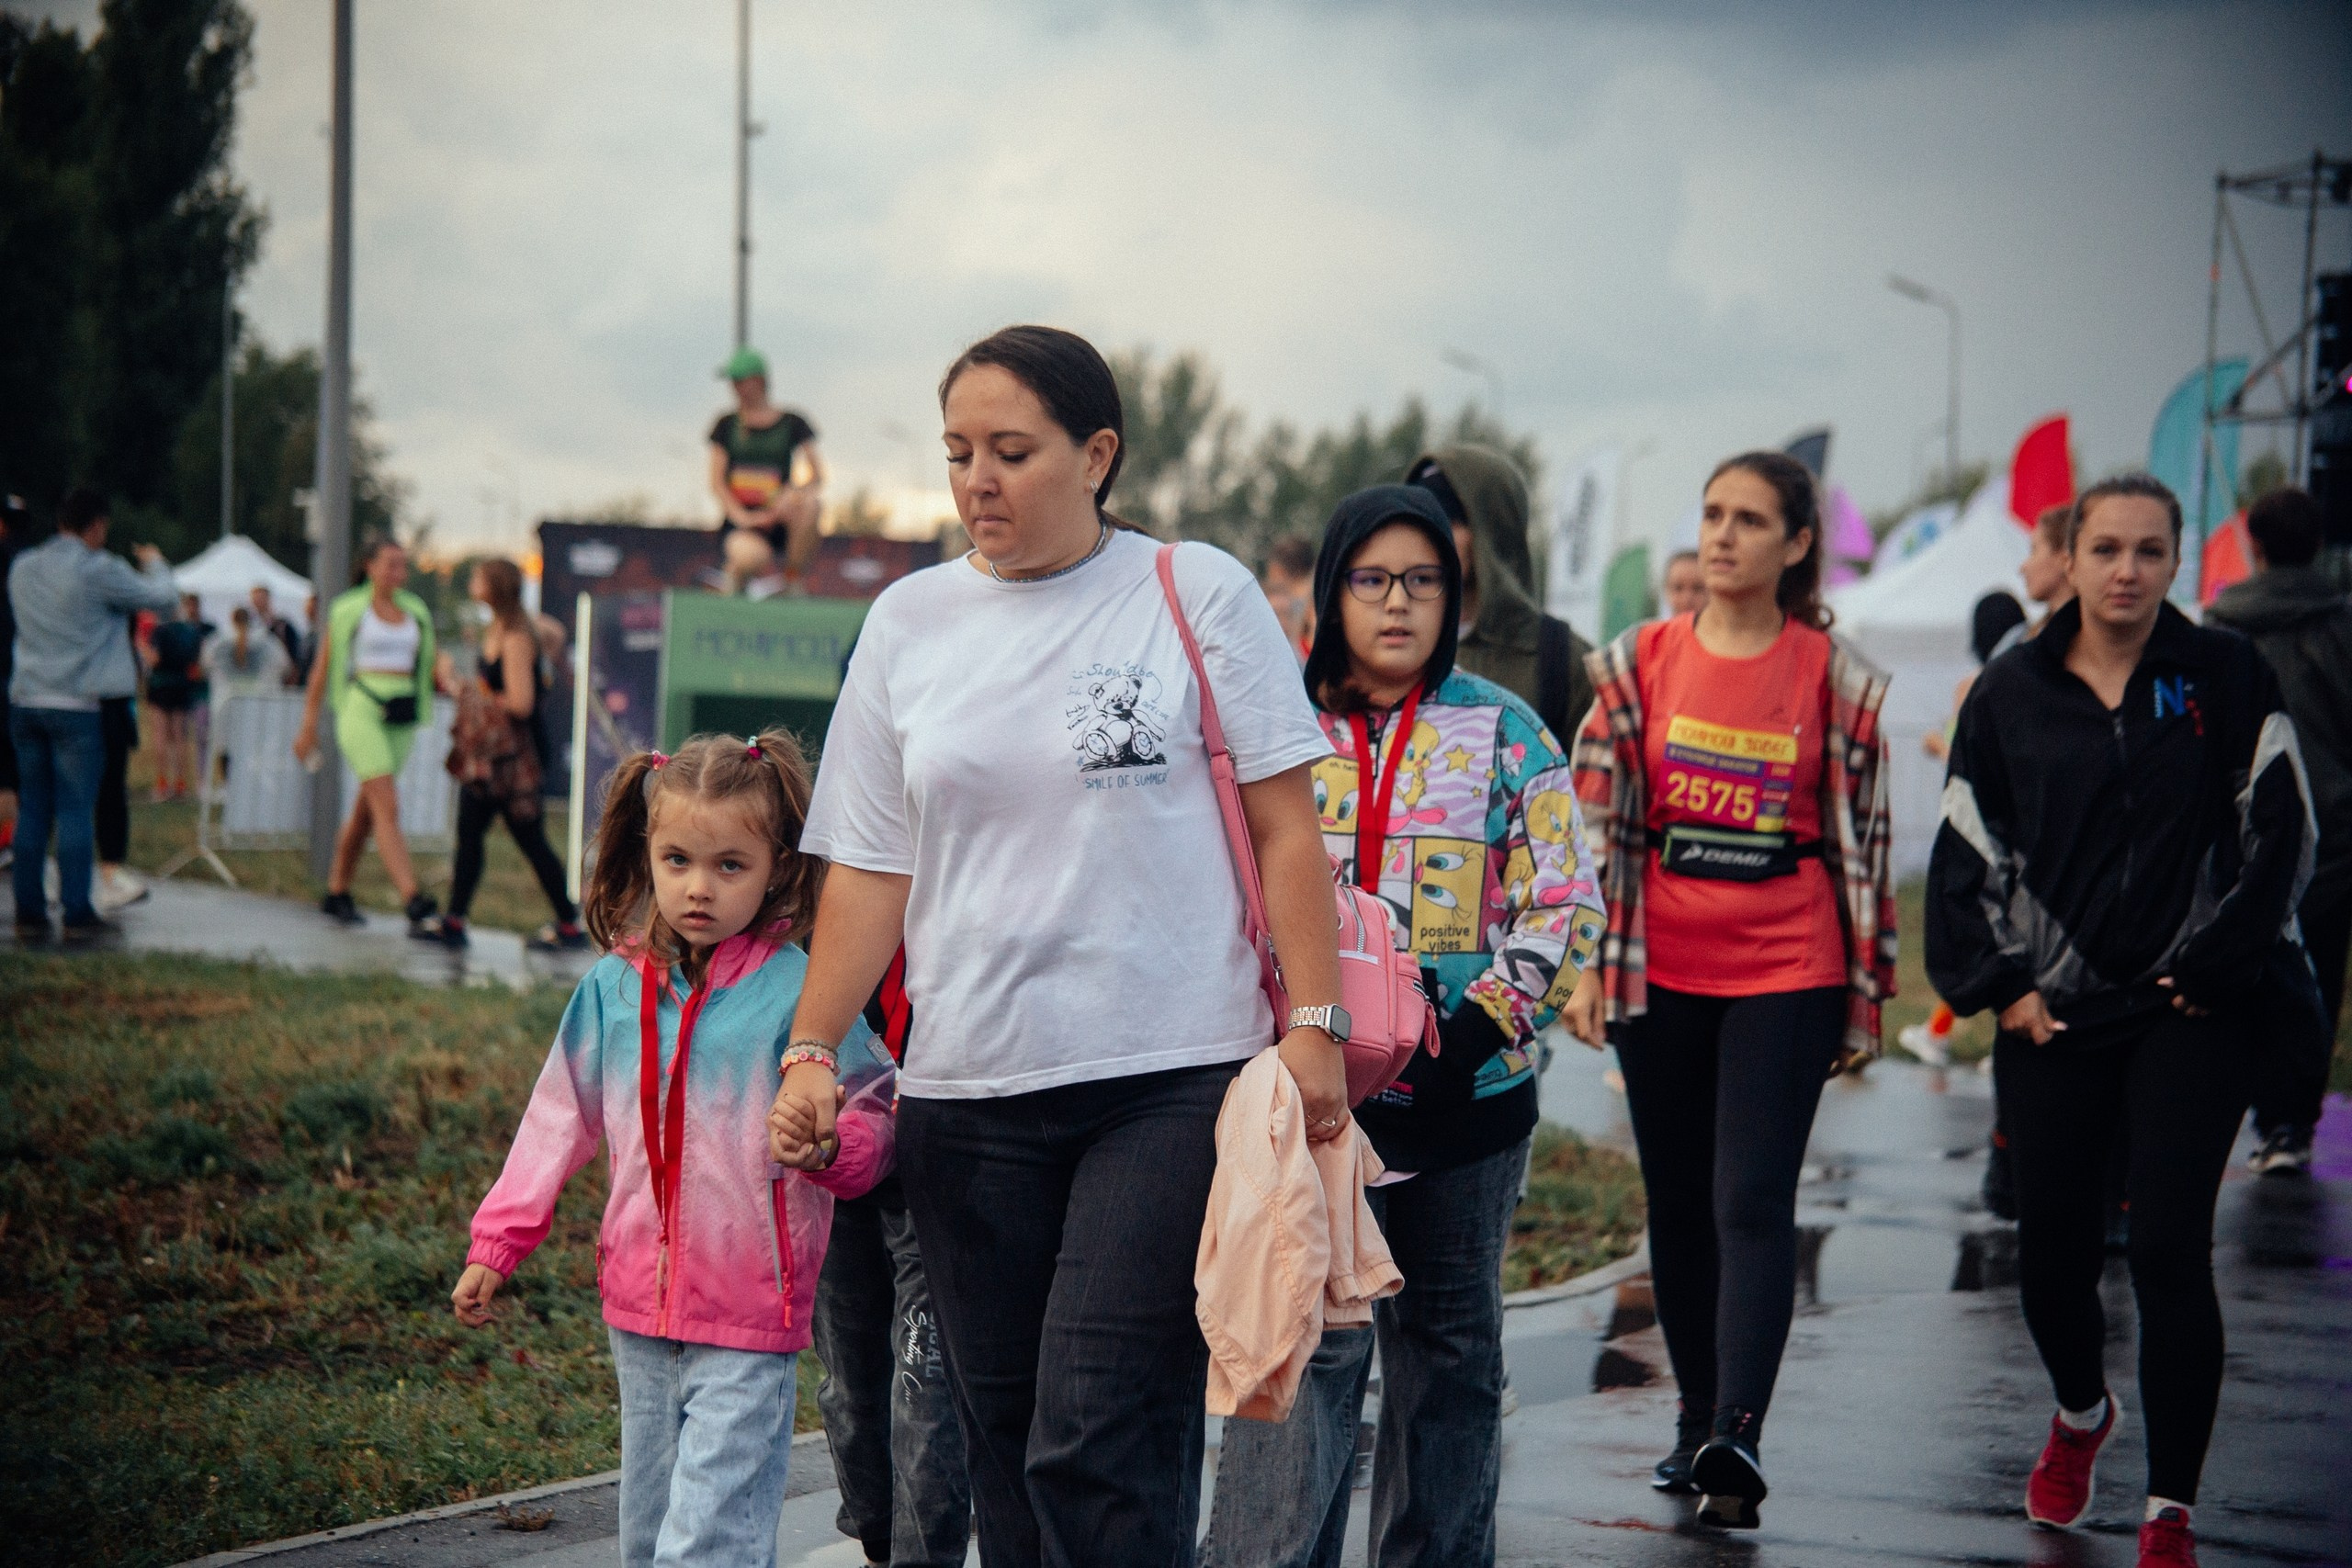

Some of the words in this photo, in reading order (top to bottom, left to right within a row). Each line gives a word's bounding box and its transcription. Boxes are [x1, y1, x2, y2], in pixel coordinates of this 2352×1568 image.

[1085, 775, 1113, 790] SMILE
[1117, 774, 1130, 788] OF
[1134, 772, 1168, 787] SUMMER
[1665, 770, 1757, 822] 2575
[1420, 924, 1470, 940] positive
[1429, 938, 1462, 953] vibes
[902, 1304, 928, 1366] Sporting
